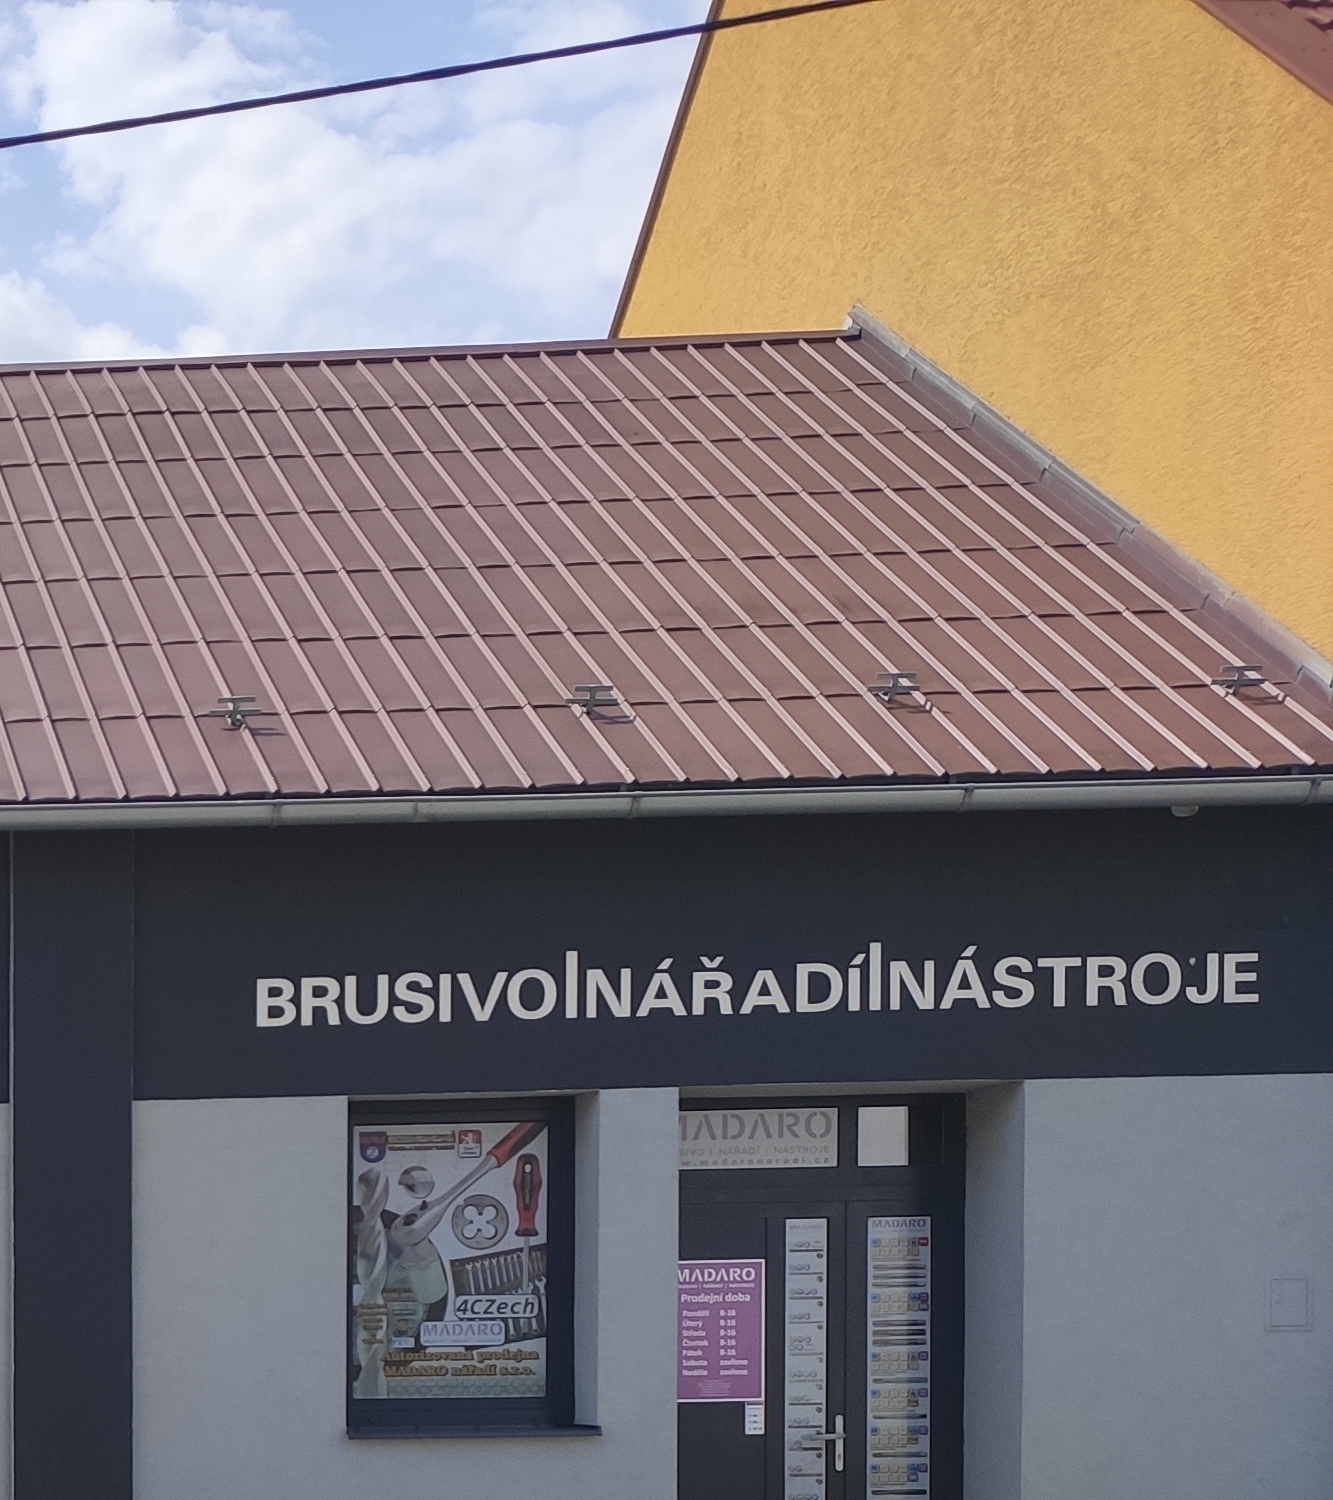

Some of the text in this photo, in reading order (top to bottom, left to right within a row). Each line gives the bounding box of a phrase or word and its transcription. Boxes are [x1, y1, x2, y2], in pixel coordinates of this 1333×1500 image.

[871, 1218, 926, 1229] MADARO
[681, 1291, 751, 1304] Prodejní doba
[456, 1297, 535, 1315] 4CZech
[422, 1322, 503, 1337] MADARO
